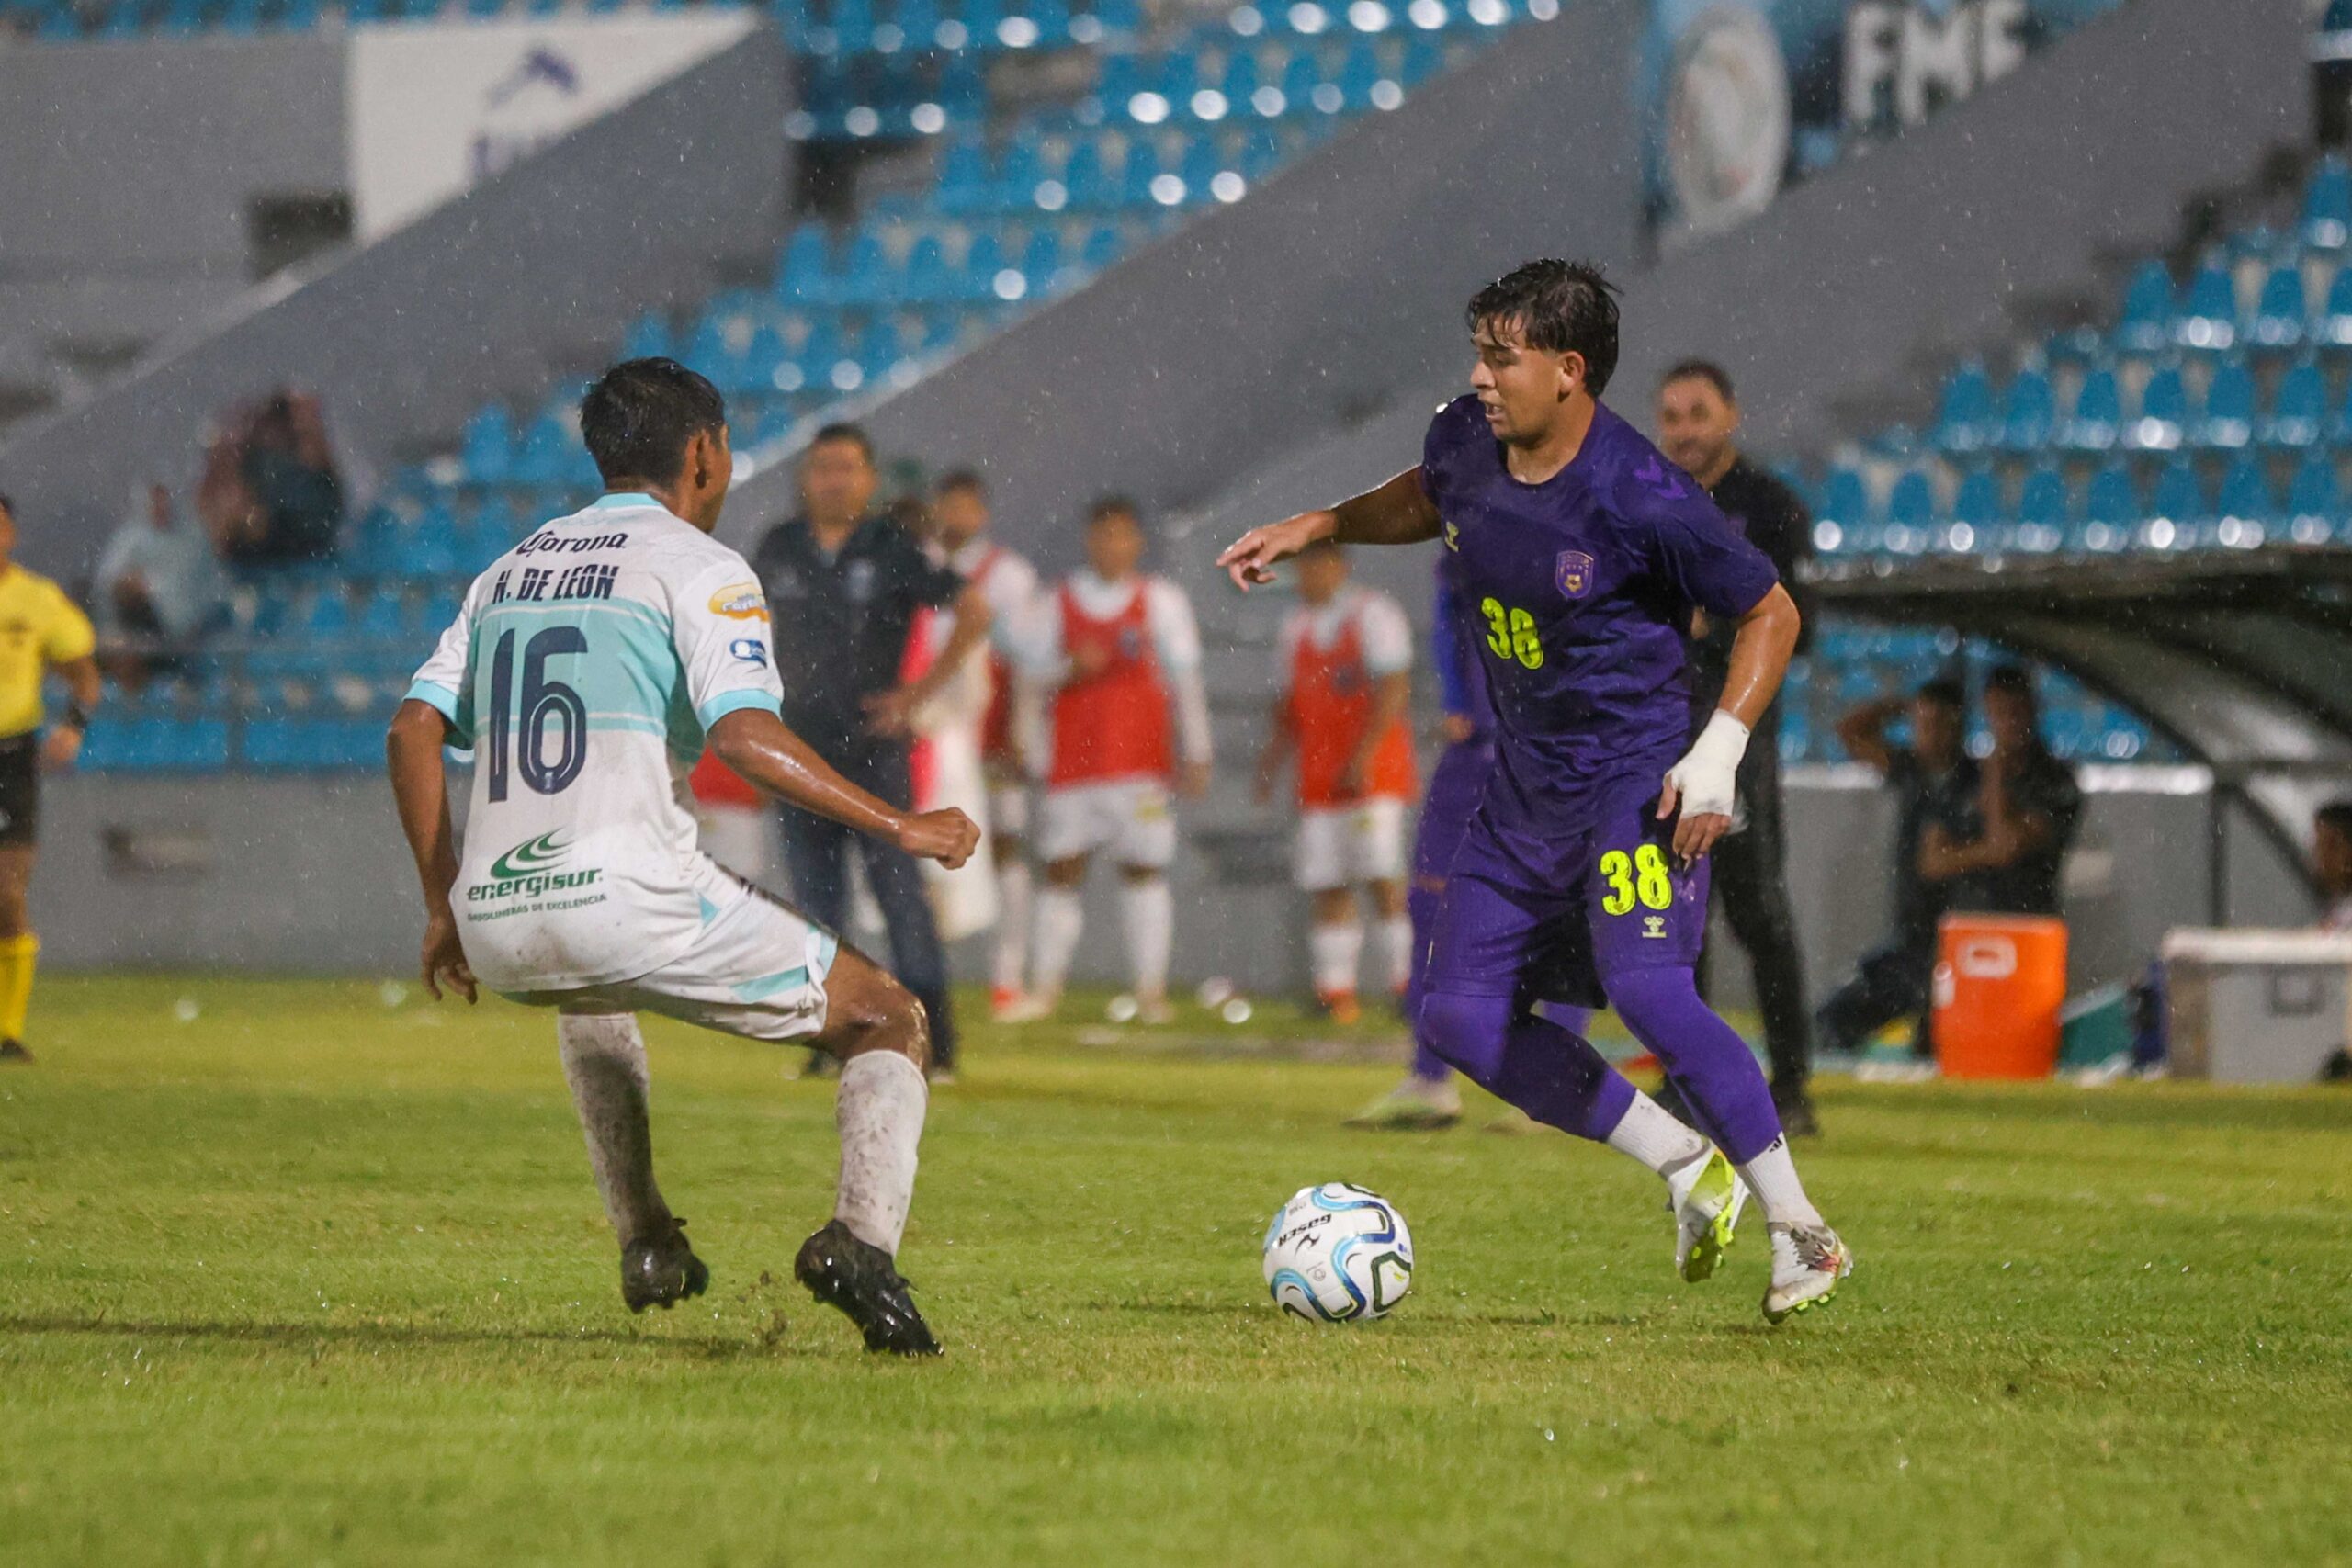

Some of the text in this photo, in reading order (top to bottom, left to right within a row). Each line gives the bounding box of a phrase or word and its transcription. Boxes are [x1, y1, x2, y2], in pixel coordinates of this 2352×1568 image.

[515, 530, 629, 558] Corona
[516, 567, 554, 602] DE
[1481, 597, 1544, 670] 38
[488, 626, 588, 803] 16
[467, 868, 603, 901] energisur
[1600, 843, 1672, 916] 38
[531, 902, 544, 912] DE
[546, 893, 607, 911] EXCELENCIA
